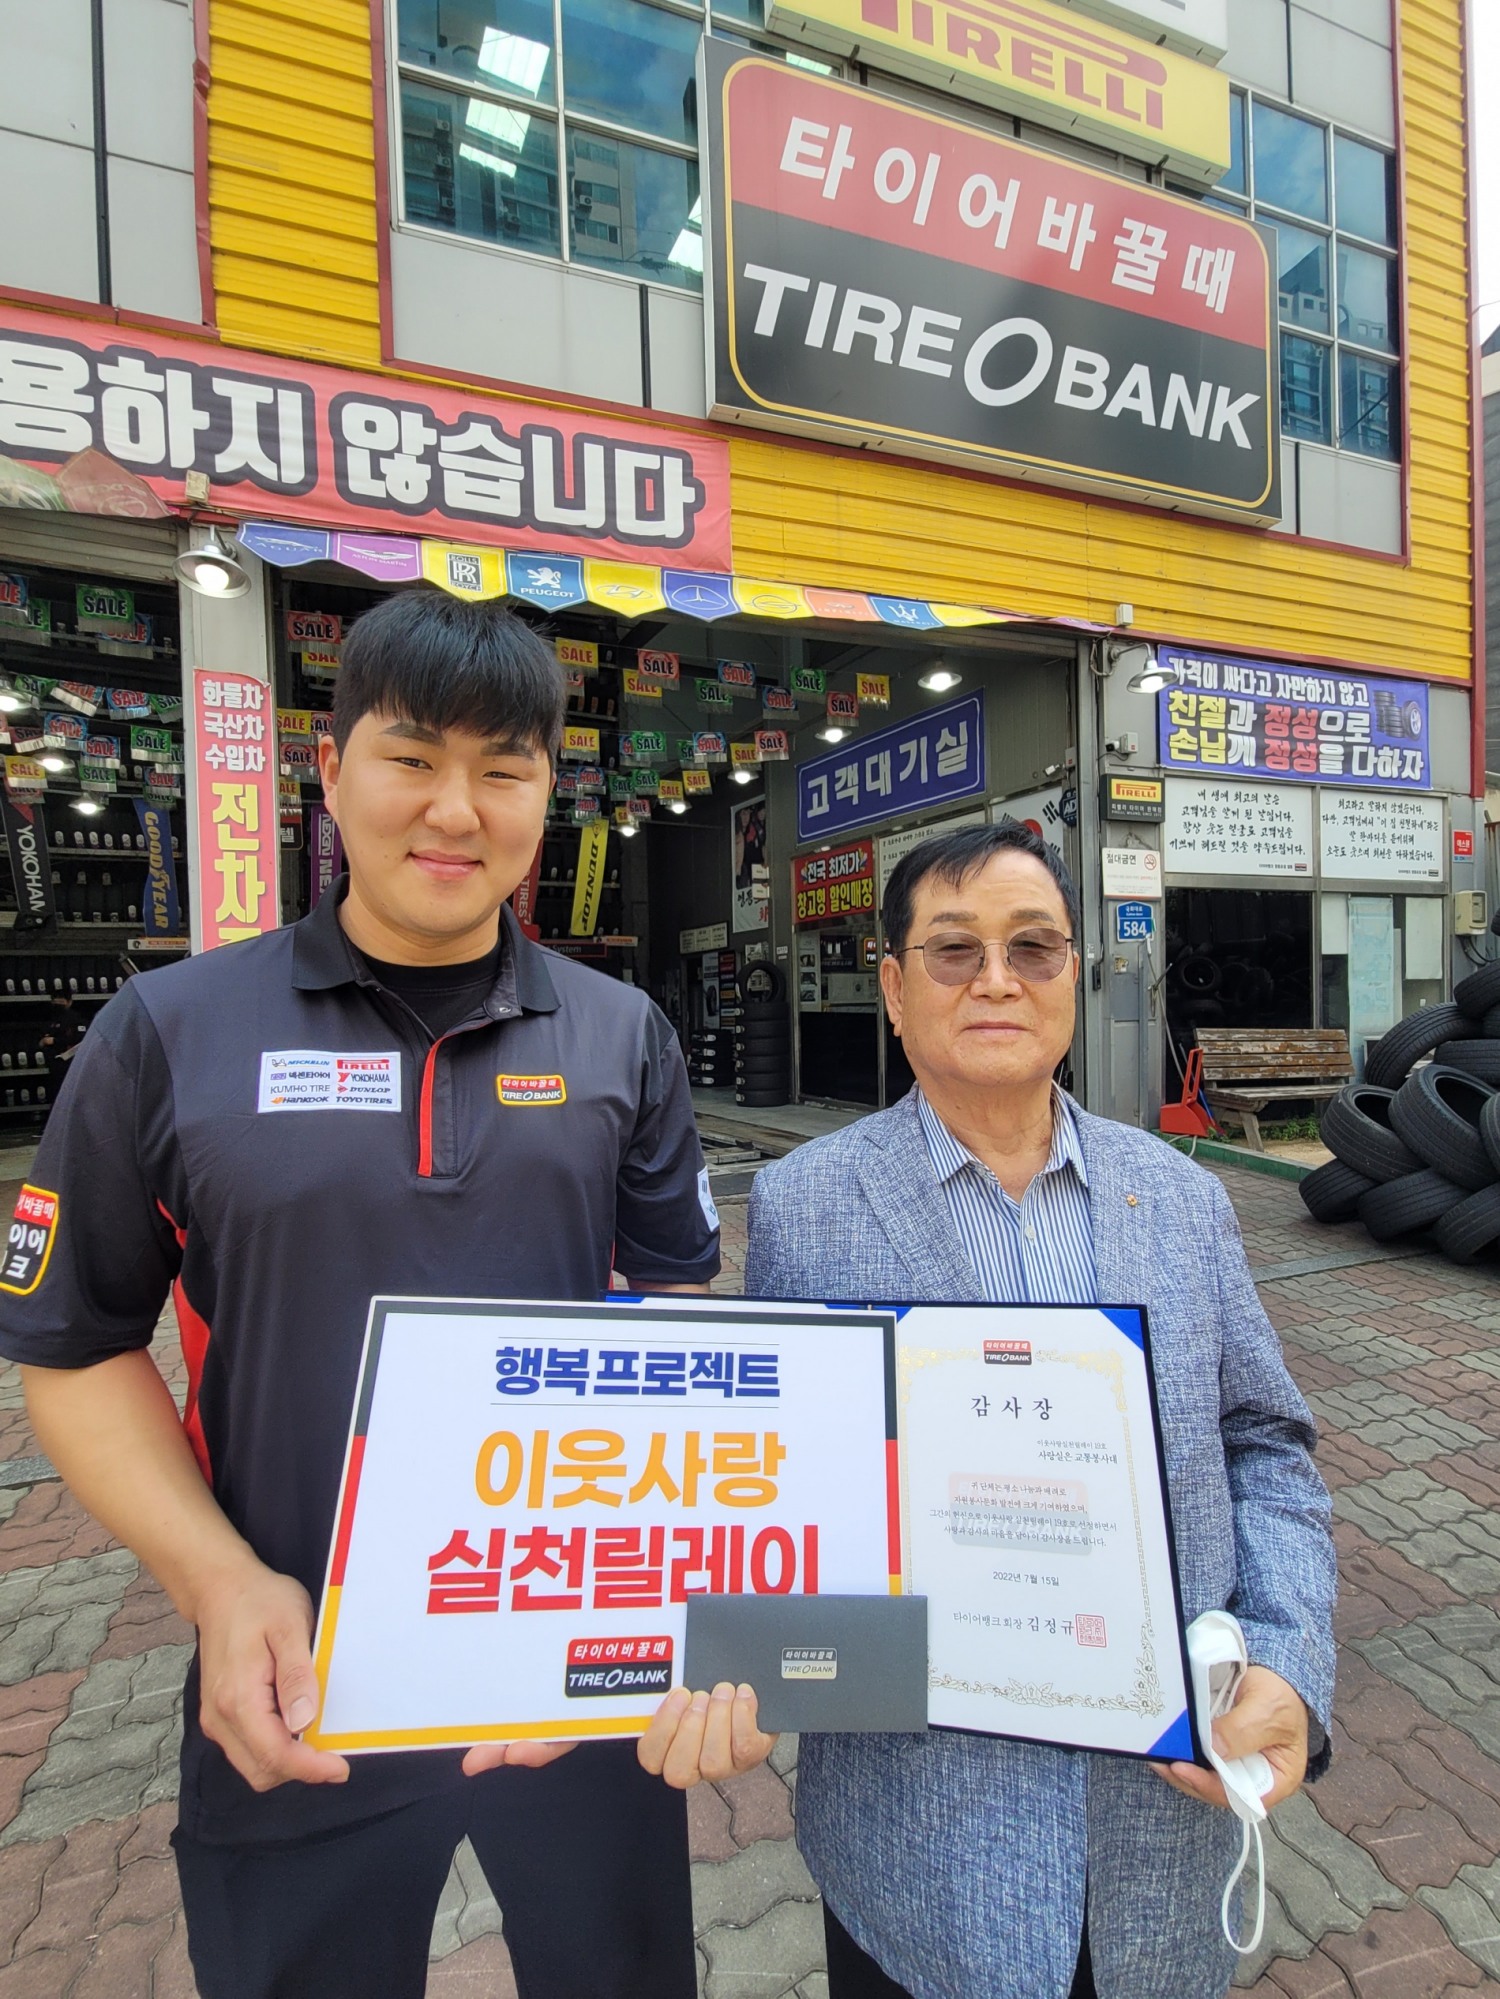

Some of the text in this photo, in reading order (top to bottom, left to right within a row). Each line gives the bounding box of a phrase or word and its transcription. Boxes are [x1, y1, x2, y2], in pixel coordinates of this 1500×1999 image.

[861, 0, 1168, 130] PIRELLI
[743, 263, 1261, 450] TIREOBANK
[341, 401, 695, 538] 않습니다
[520, 587, 575, 597] PEUGEOT
[83, 595, 128, 617] SALE
[293, 621, 335, 639] SALE
[561, 646, 593, 664] SALE
[643, 659, 674, 675] SALE
[722, 666, 753, 685] SALE
[795, 675, 822, 691] SALE
[1169, 657, 1370, 707] 가격이 싸다고 자만하지 않고
[202, 680, 264, 710] 화물차
[861, 681, 886, 696] SALE
[112, 691, 147, 706] SALE
[767, 693, 794, 708] SALE
[832, 700, 856, 714] SALE
[277, 715, 305, 730] SALE
[1168, 690, 1371, 743] 친절과 정성으로
[49, 720, 83, 737] SALE
[203, 711, 265, 741] 국산차
[86, 741, 115, 756] SALE
[136, 735, 167, 750] SALE
[569, 735, 595, 748] SALE
[636, 738, 662, 751] SALE
[697, 738, 724, 752] SALE
[759, 738, 783, 750] SALE
[205, 745, 266, 772] 수입차
[284, 750, 313, 764] SALE
[735, 749, 756, 761] SALE
[1169, 728, 1424, 780] 손님께 정성을 다하자
[10, 763, 40, 777] SALE
[83, 768, 112, 781] SALE
[807, 721, 968, 819] 고객대기실
[149, 773, 175, 786] SALE
[579, 772, 601, 784] SALE
[636, 774, 656, 785] SALE
[686, 776, 707, 787] SALE
[612, 781, 633, 793] SALE
[661, 785, 681, 797] SALE
[1116, 783, 1156, 798] PIRELLI
[1234, 791, 1259, 804] 최고의
[629, 803, 648, 814] SALE
[1181, 805, 1217, 818] 고객님을
[1183, 822, 1293, 839] 항상 웃는 얼굴로 고객님을
[1169, 838, 1196, 850] 기쁘게
[808, 860, 827, 883] 전국
[829, 851, 860, 877] 최저가
[1107, 853, 1137, 866] 절대금연
[144, 811, 170, 929] GOODYEAR
[582, 841, 599, 932] DUNLOP
[797, 888, 826, 919] 창고형
[830, 878, 873, 912] 할인매장
[1123, 921, 1147, 937] 584
[337, 1059, 390, 1070] PIRELLI
[289, 1071, 331, 1080] 넥센타이어
[350, 1074, 390, 1082] YOKOHAMA
[270, 1086, 307, 1094] KUMHO
[985, 1353, 1030, 1362] TIREOBANK
[1038, 1451, 1118, 1464] 사랑실은 교통봉사대
[474, 1429, 786, 1508] 이웃사랑
[1004, 1484, 1018, 1492] 평소
[1020, 1485, 1042, 1495] 나눔과
[1044, 1486, 1067, 1496] 배려로
[1000, 1498, 1021, 1508] 발전에
[1023, 1500, 1037, 1510] 크게
[929, 1509, 951, 1518] 그간의
[953, 1511, 982, 1521] 헌신으로
[983, 1512, 1013, 1524] 이웃사랑
[1015, 1515, 1053, 1527] 실천릴레이
[1078, 1519, 1117, 1532] 선정하면서
[944, 1525, 966, 1536] 사랑과
[967, 1527, 989, 1537] 감사의
[991, 1529, 1014, 1540] 마음을
[1041, 1534, 1072, 1545] 감사장을
[427, 1525, 818, 1614] 실천릴레이
[993, 1571, 1060, 1587] 2022년 7월 15일
[953, 1611, 1002, 1627] 타이어뱅크
[1003, 1615, 1023, 1630] 회장
[783, 1664, 834, 1673] TIREOBANK
[569, 1669, 668, 1688] TIREOBANK
